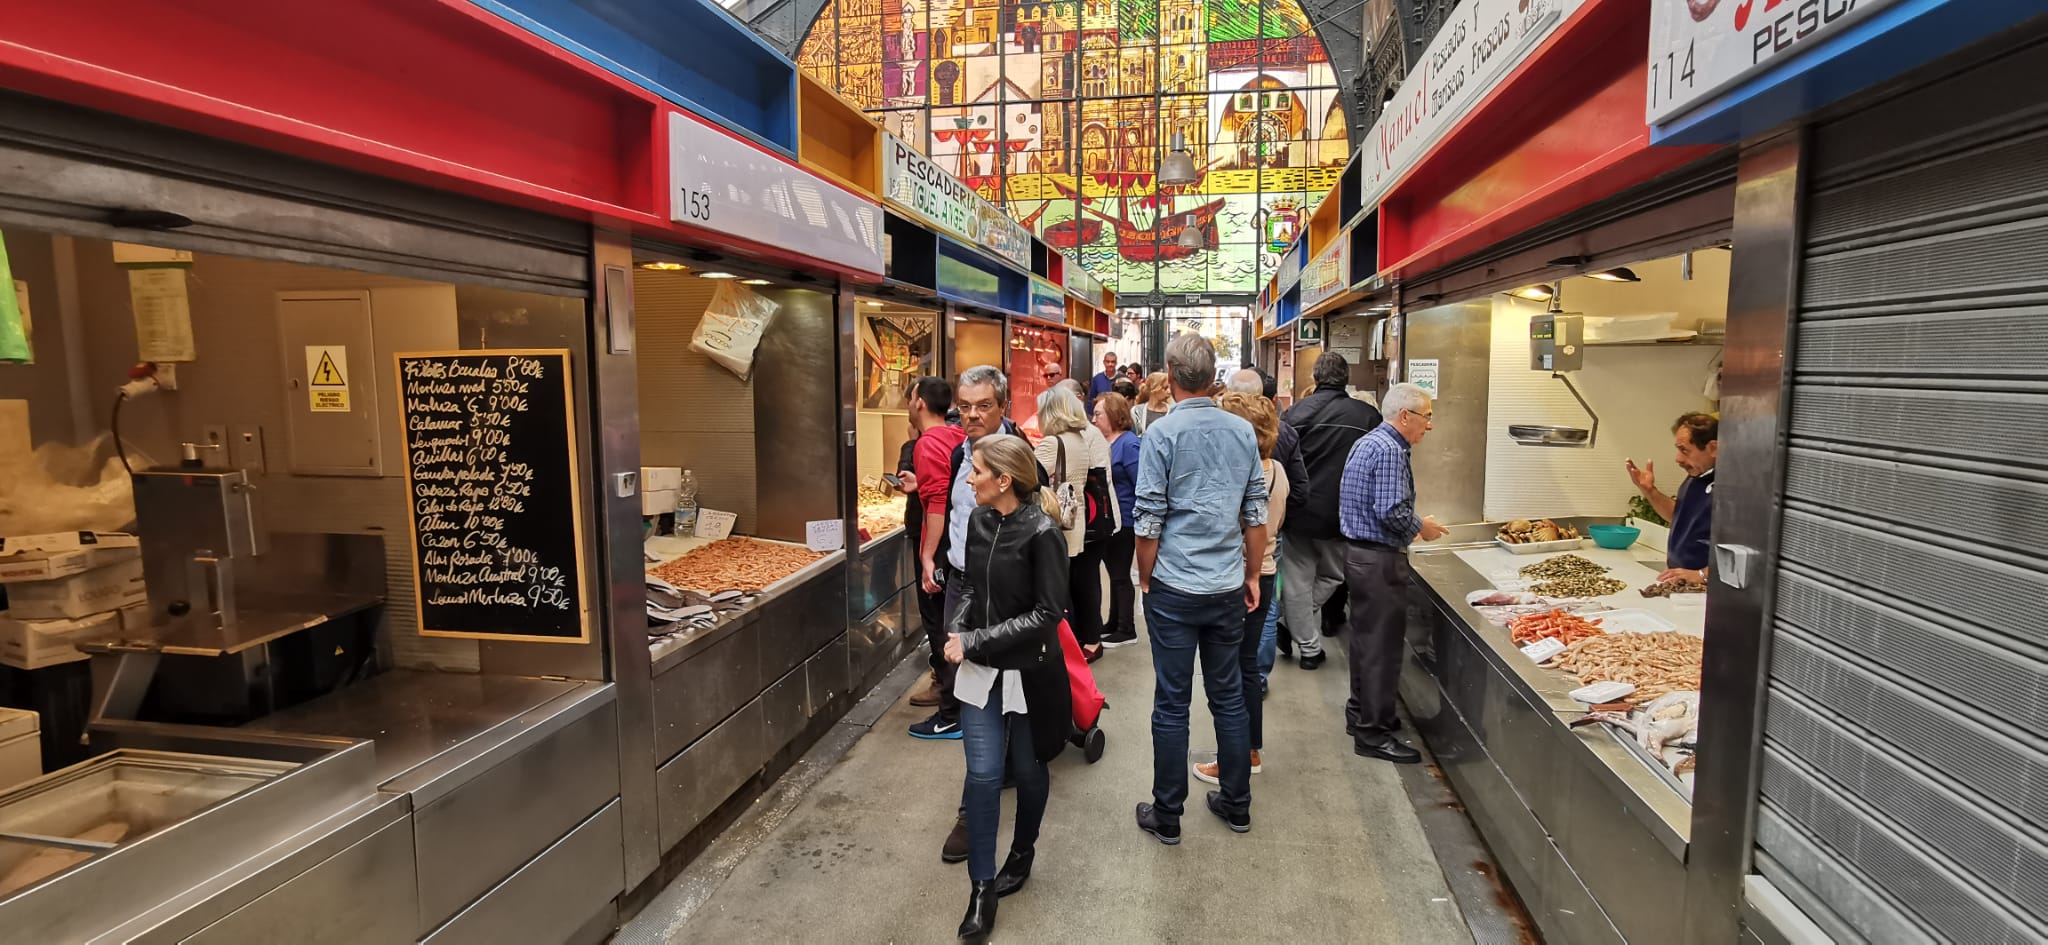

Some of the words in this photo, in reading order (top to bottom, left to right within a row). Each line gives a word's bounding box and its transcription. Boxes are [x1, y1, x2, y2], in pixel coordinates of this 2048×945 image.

[1431, 64, 1465, 118] Mariscos
[1472, 12, 1510, 75] Frescos
[1432, 18, 1466, 80] Pescados
[1652, 37, 1696, 108] 114
[1376, 61, 1430, 182] Manuel
[681, 187, 710, 221] 153
[895, 143, 977, 214] PESCADERIA
[408, 380, 456, 395] Merluza
[408, 396, 461, 413] Merluza
[409, 415, 463, 430] Calamar
